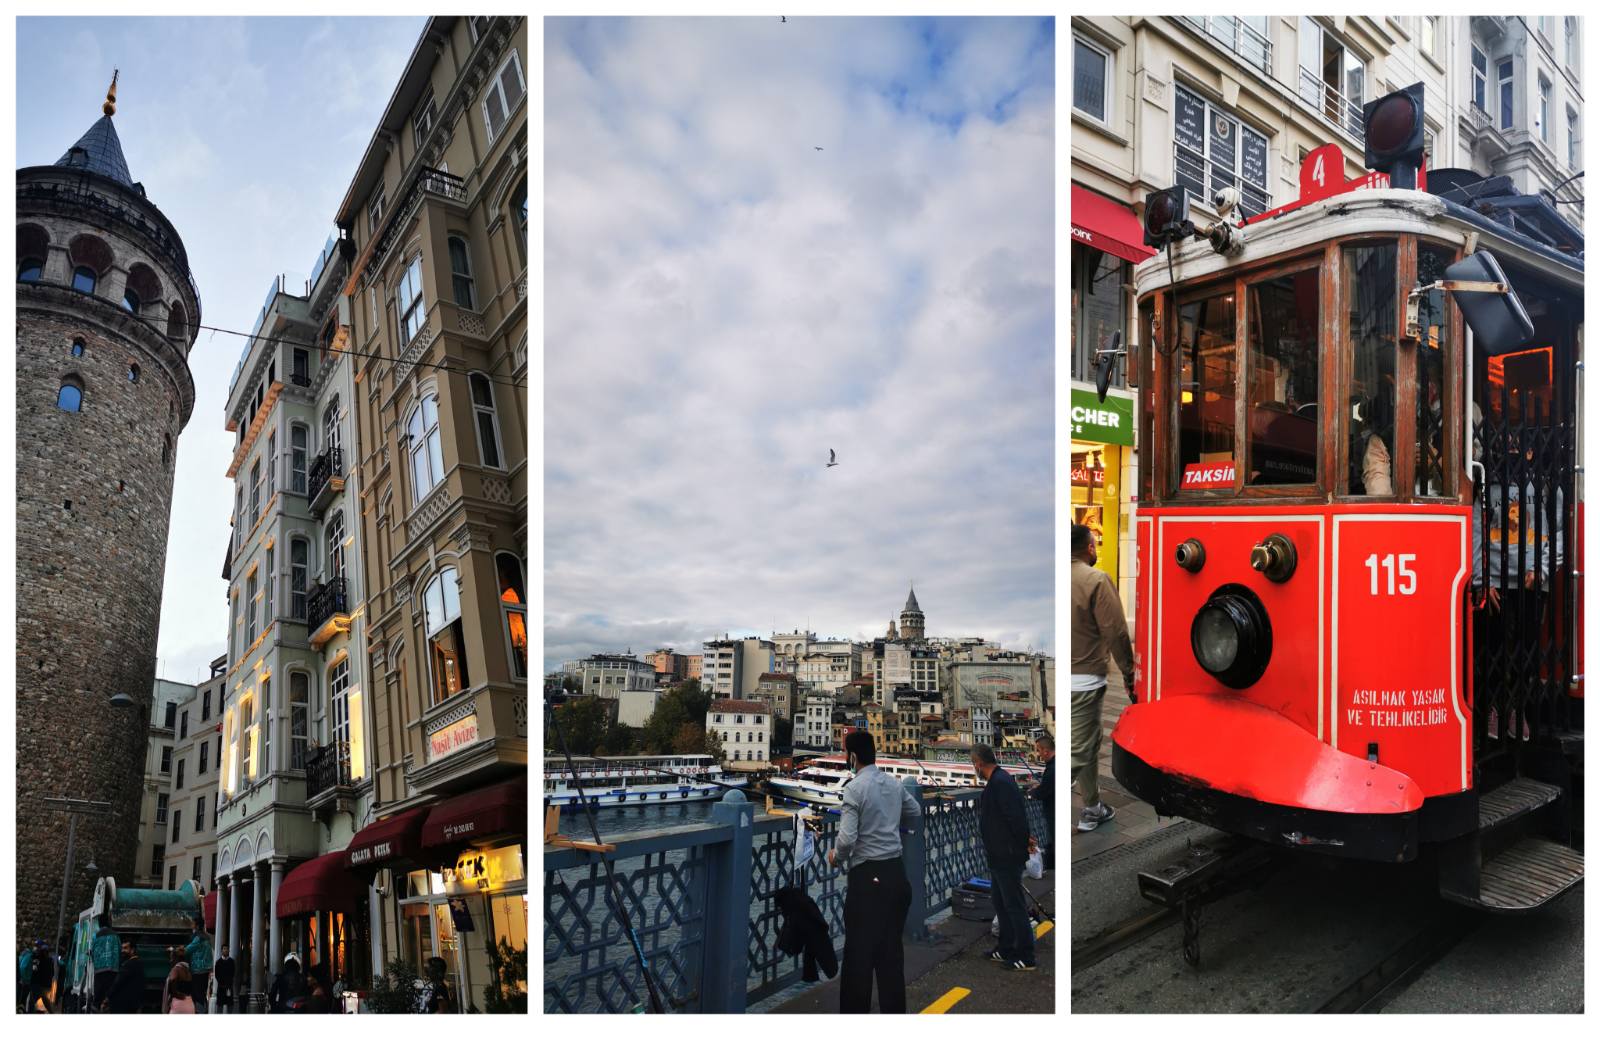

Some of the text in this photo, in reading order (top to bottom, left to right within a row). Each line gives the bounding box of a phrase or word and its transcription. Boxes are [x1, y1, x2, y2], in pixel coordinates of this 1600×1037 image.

[1312, 154, 1325, 187] 4
[1365, 553, 1417, 595] 115
[1412, 688, 1445, 705] YASAK
[1347, 709, 1363, 726] VE
